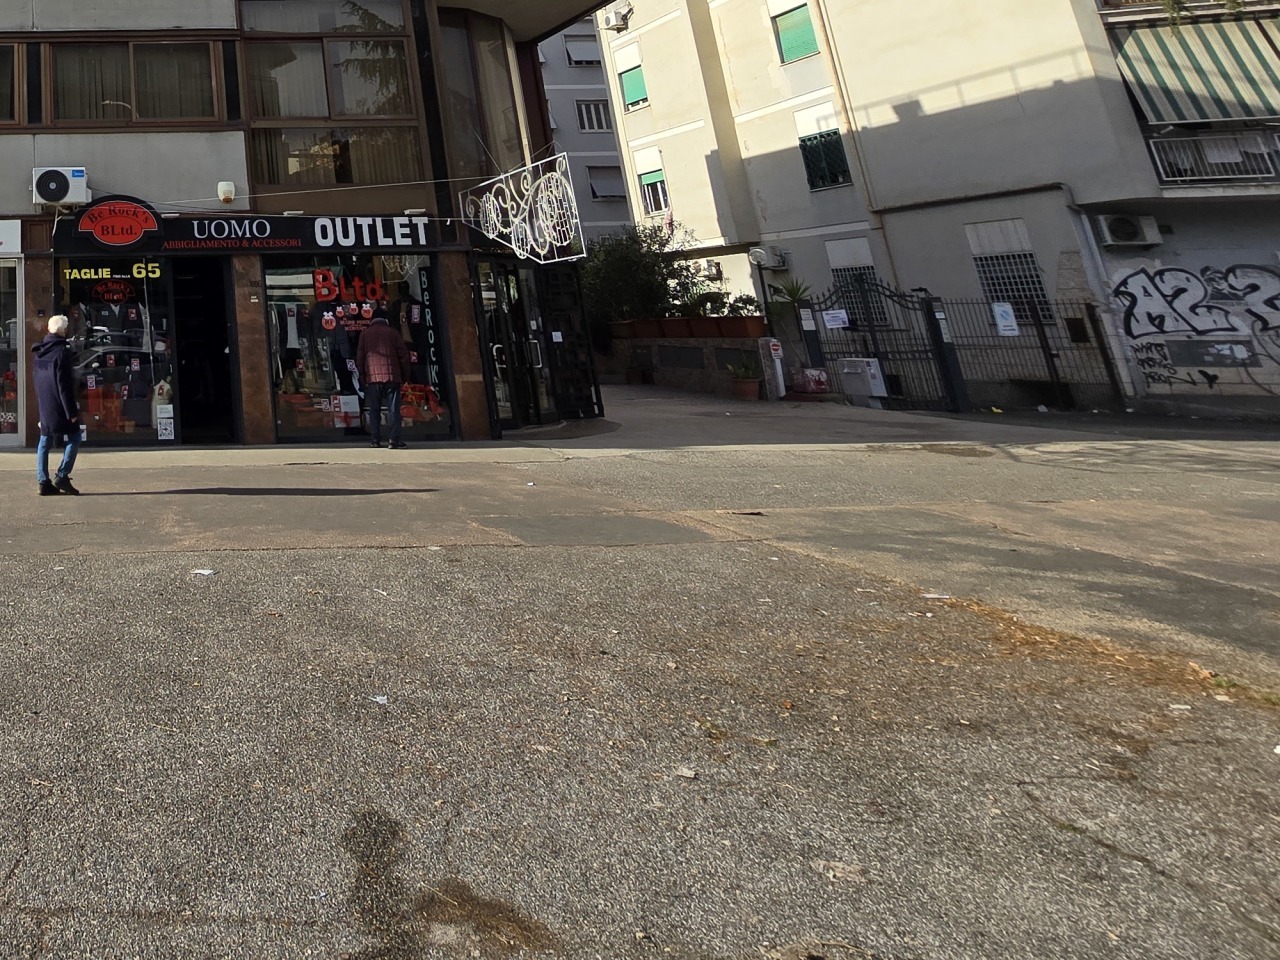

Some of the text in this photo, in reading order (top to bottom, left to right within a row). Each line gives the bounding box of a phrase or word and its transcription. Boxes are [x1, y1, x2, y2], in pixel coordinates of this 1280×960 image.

[86, 204, 151, 224] Be Rock's
[100, 224, 138, 236] BLtd.
[191, 219, 271, 239] UOMO
[314, 216, 429, 247] OUTLET
[162, 238, 302, 249] ABBIGLIAMENTO & ACCESSORI
[63, 268, 111, 280] TAGLIE
[132, 262, 161, 279] 65
[314, 268, 390, 302] BLtd.
